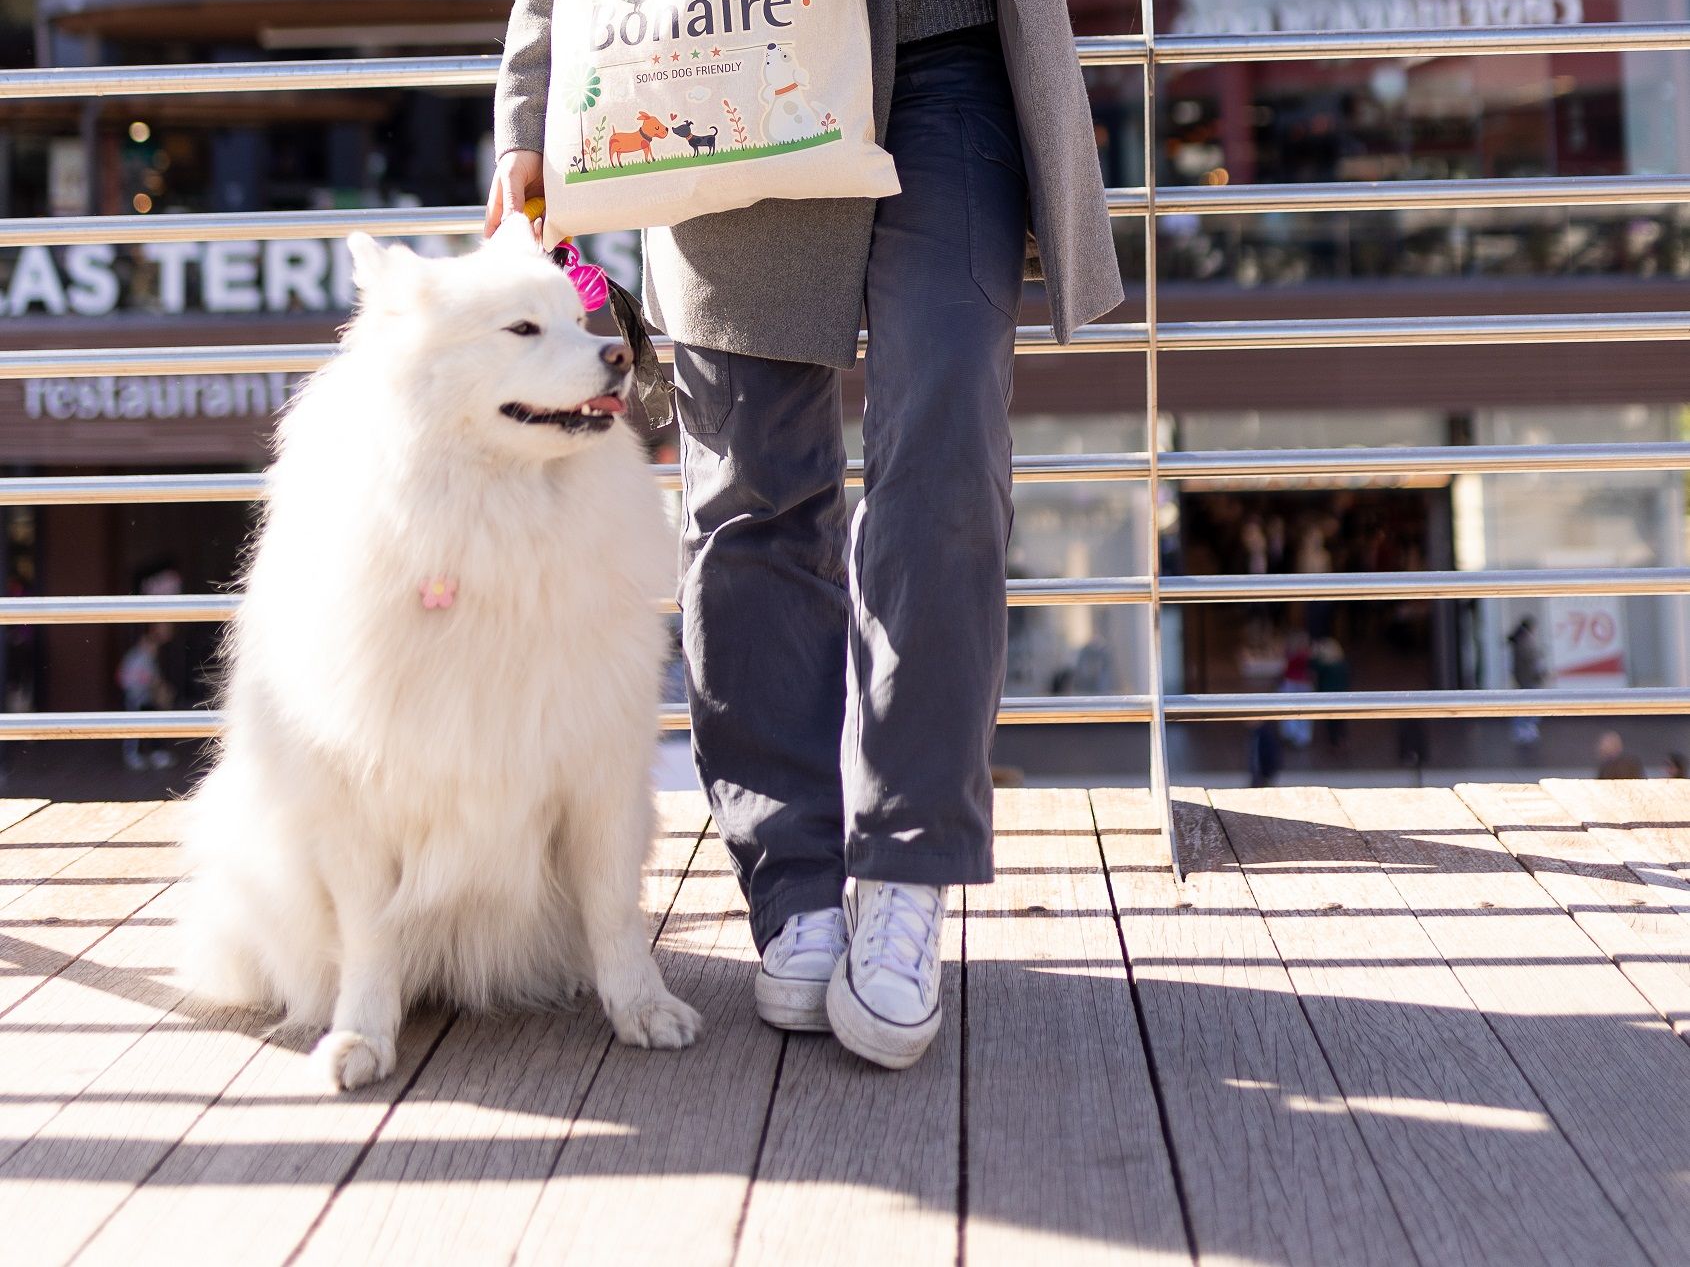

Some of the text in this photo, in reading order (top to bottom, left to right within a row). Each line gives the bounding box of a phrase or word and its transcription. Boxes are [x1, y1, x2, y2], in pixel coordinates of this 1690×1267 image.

[636, 61, 742, 84] SOMOS DOG FRIENDLY
[0, 242, 120, 316] AS
[24, 373, 300, 418] restaurant
